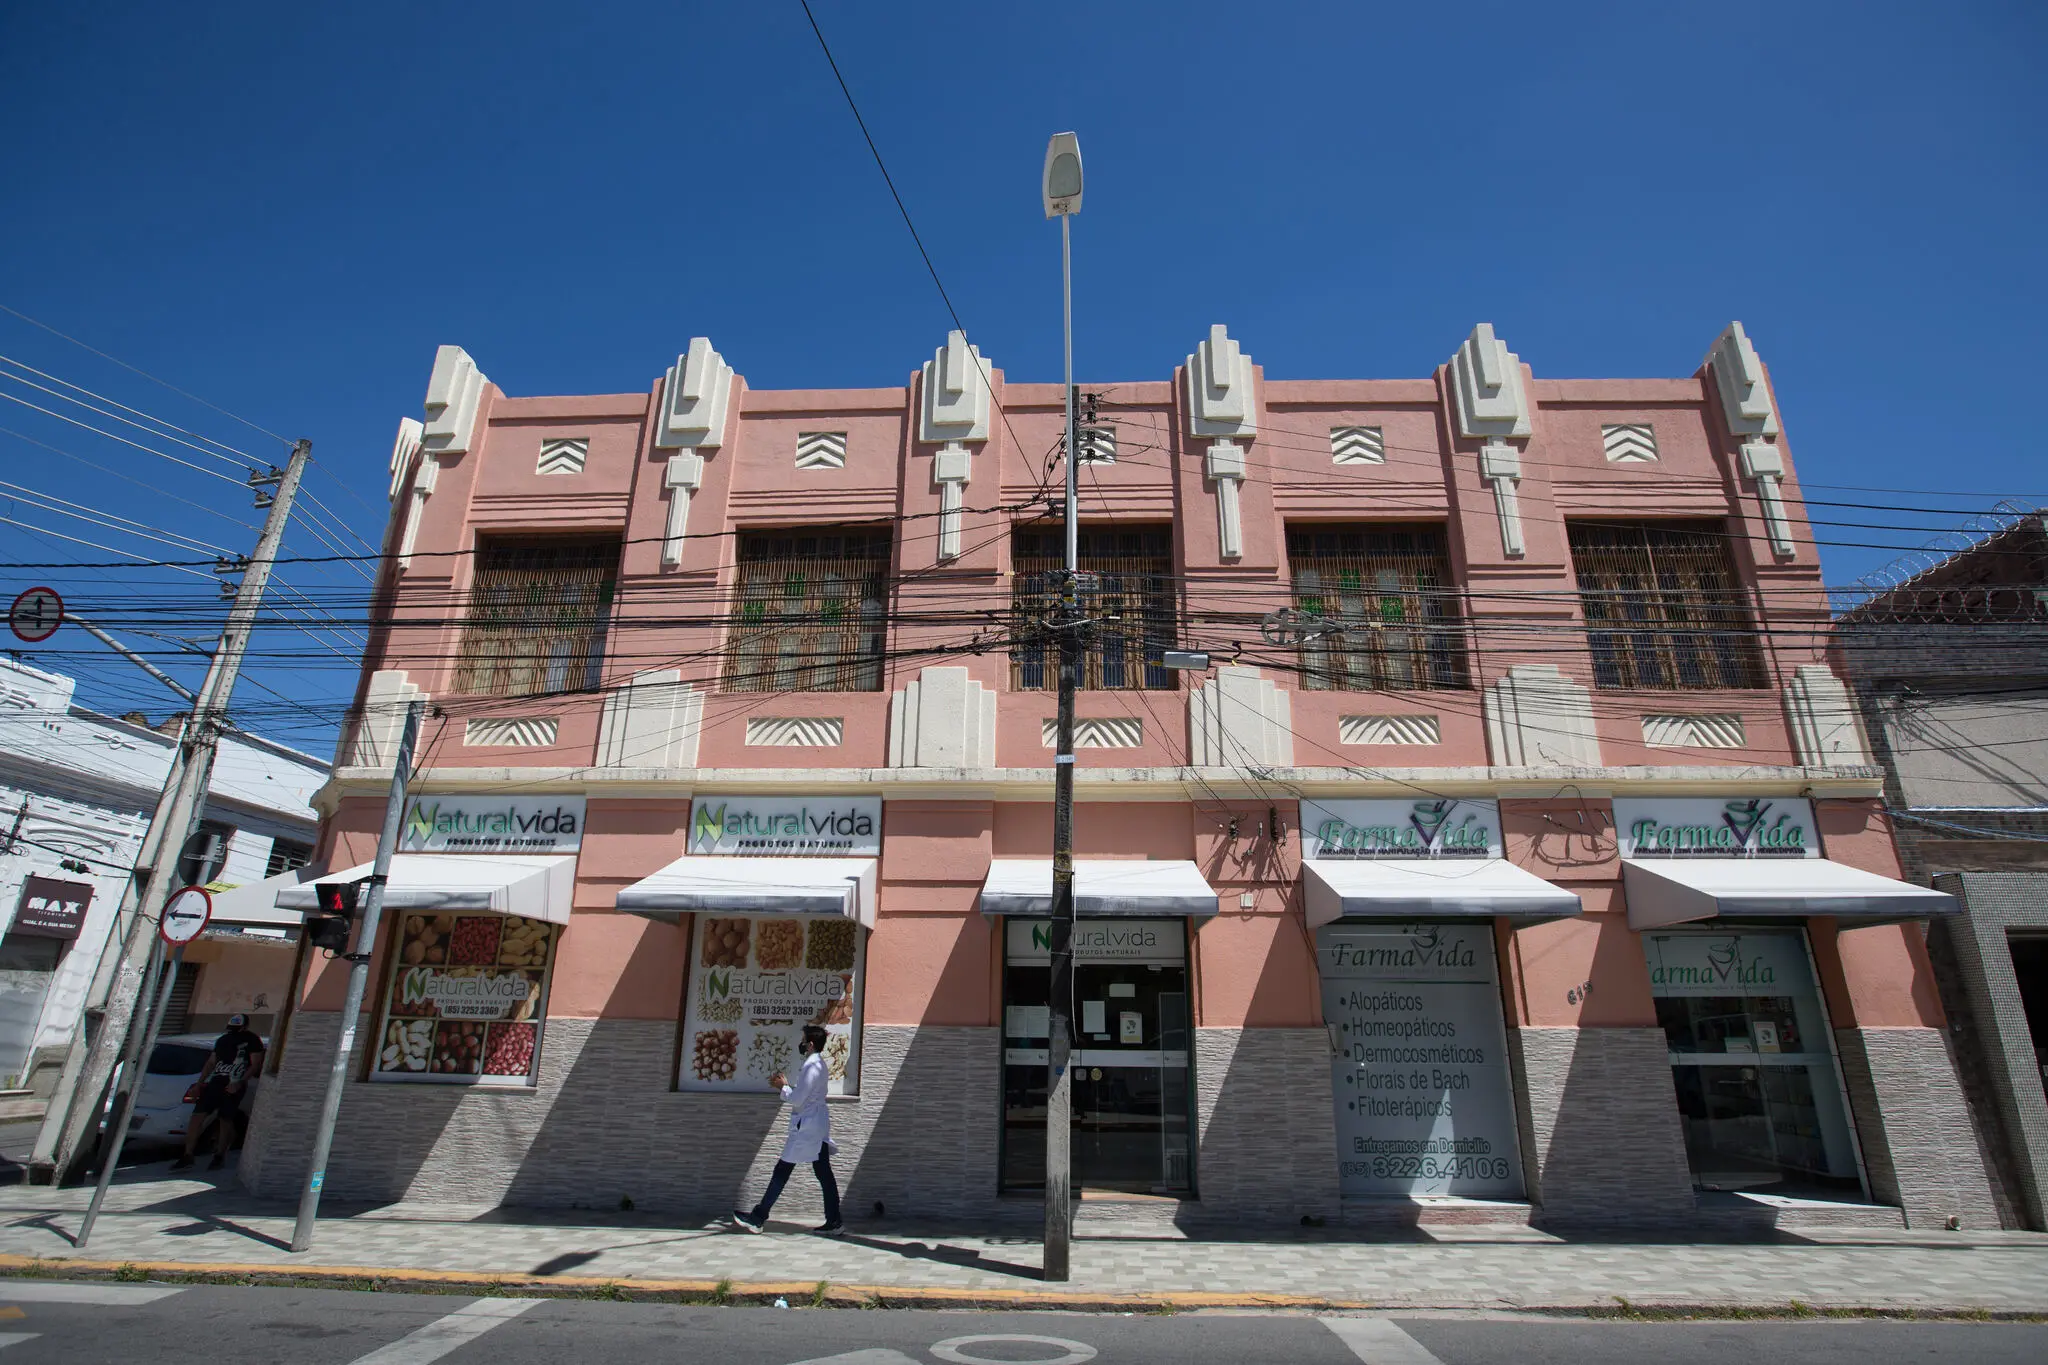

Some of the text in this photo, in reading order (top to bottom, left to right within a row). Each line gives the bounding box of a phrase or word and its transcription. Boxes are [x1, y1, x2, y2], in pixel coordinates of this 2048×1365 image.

[407, 802, 576, 842] Naturalvida
[695, 803, 873, 843] Naturalvida
[446, 838, 557, 846] PRODUTOS NATURAIS
[738, 840, 853, 848] PRODUTOS NATURAIS
[27, 897, 81, 914] MAX
[1032, 923, 1157, 951] Nuralvida
[1331, 934, 1476, 967] FarmaVida
[1649, 952, 1776, 985] armaVida
[407, 970, 528, 999] Naturalvida
[709, 969, 842, 999] Naturalvida
[771, 1006, 791, 1015] 3252
[792, 1006, 814, 1016] 3369
[786, 998, 825, 1006] NATURAIS
[1349, 991, 1423, 1015] Alopáticos
[1352, 1017, 1456, 1041] Homeopáticos
[1353, 1042, 1484, 1064] Dermocosméticos
[1356, 1069, 1470, 1089] Florais de Bach
[1358, 1095, 1453, 1121] Fitoterápicos
[1354, 1136, 1419, 1157] Entregamos
[1420, 1140, 1439, 1154] em
[1341, 1156, 1510, 1180] (85) 3226.4106
